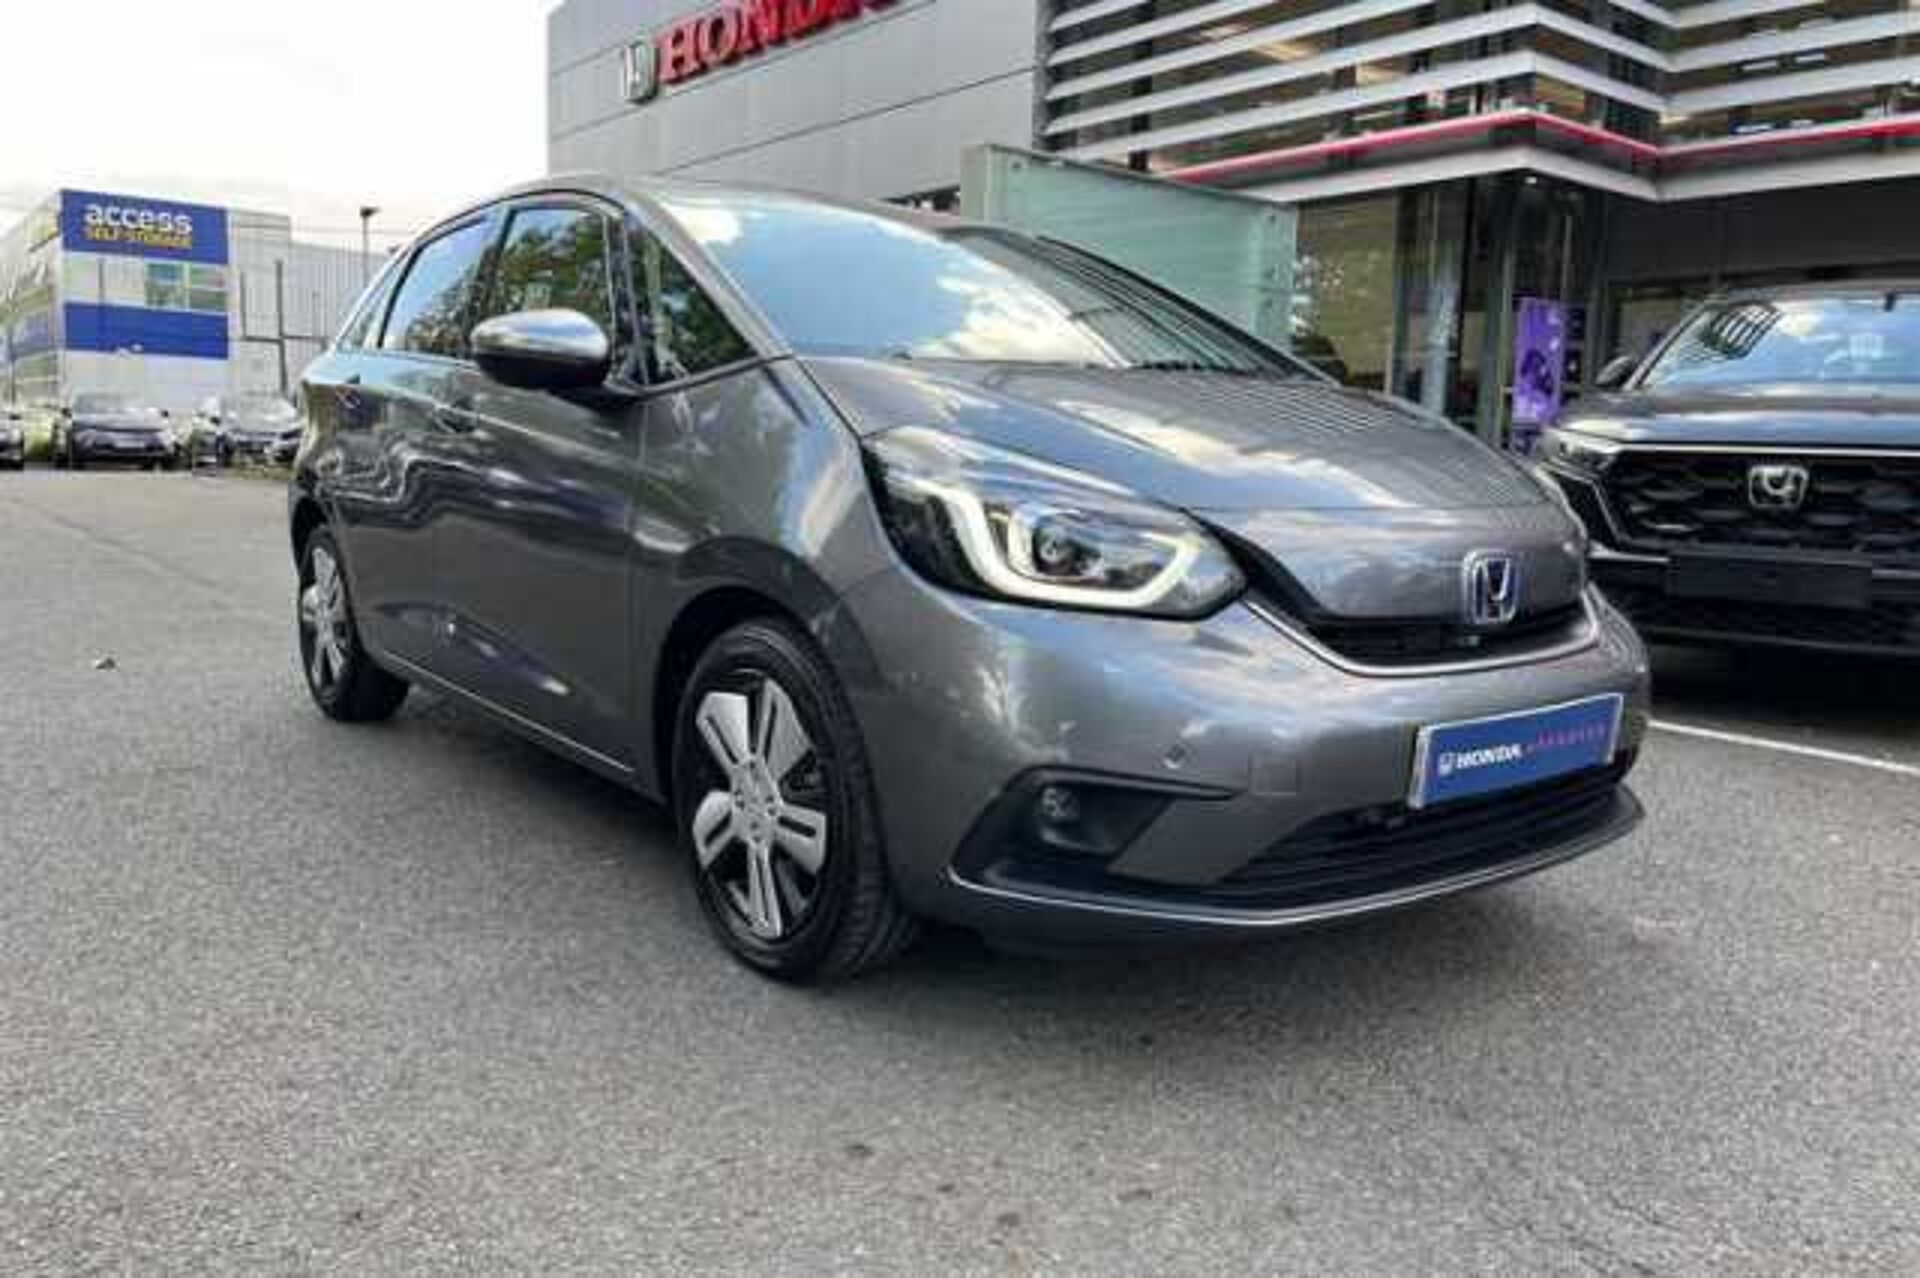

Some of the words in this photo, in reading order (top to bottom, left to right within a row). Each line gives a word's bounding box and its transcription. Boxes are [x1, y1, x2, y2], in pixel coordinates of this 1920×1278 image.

[658, 0, 899, 84] HOND
[84, 203, 193, 235] access
[1456, 744, 1522, 769] HONDA
